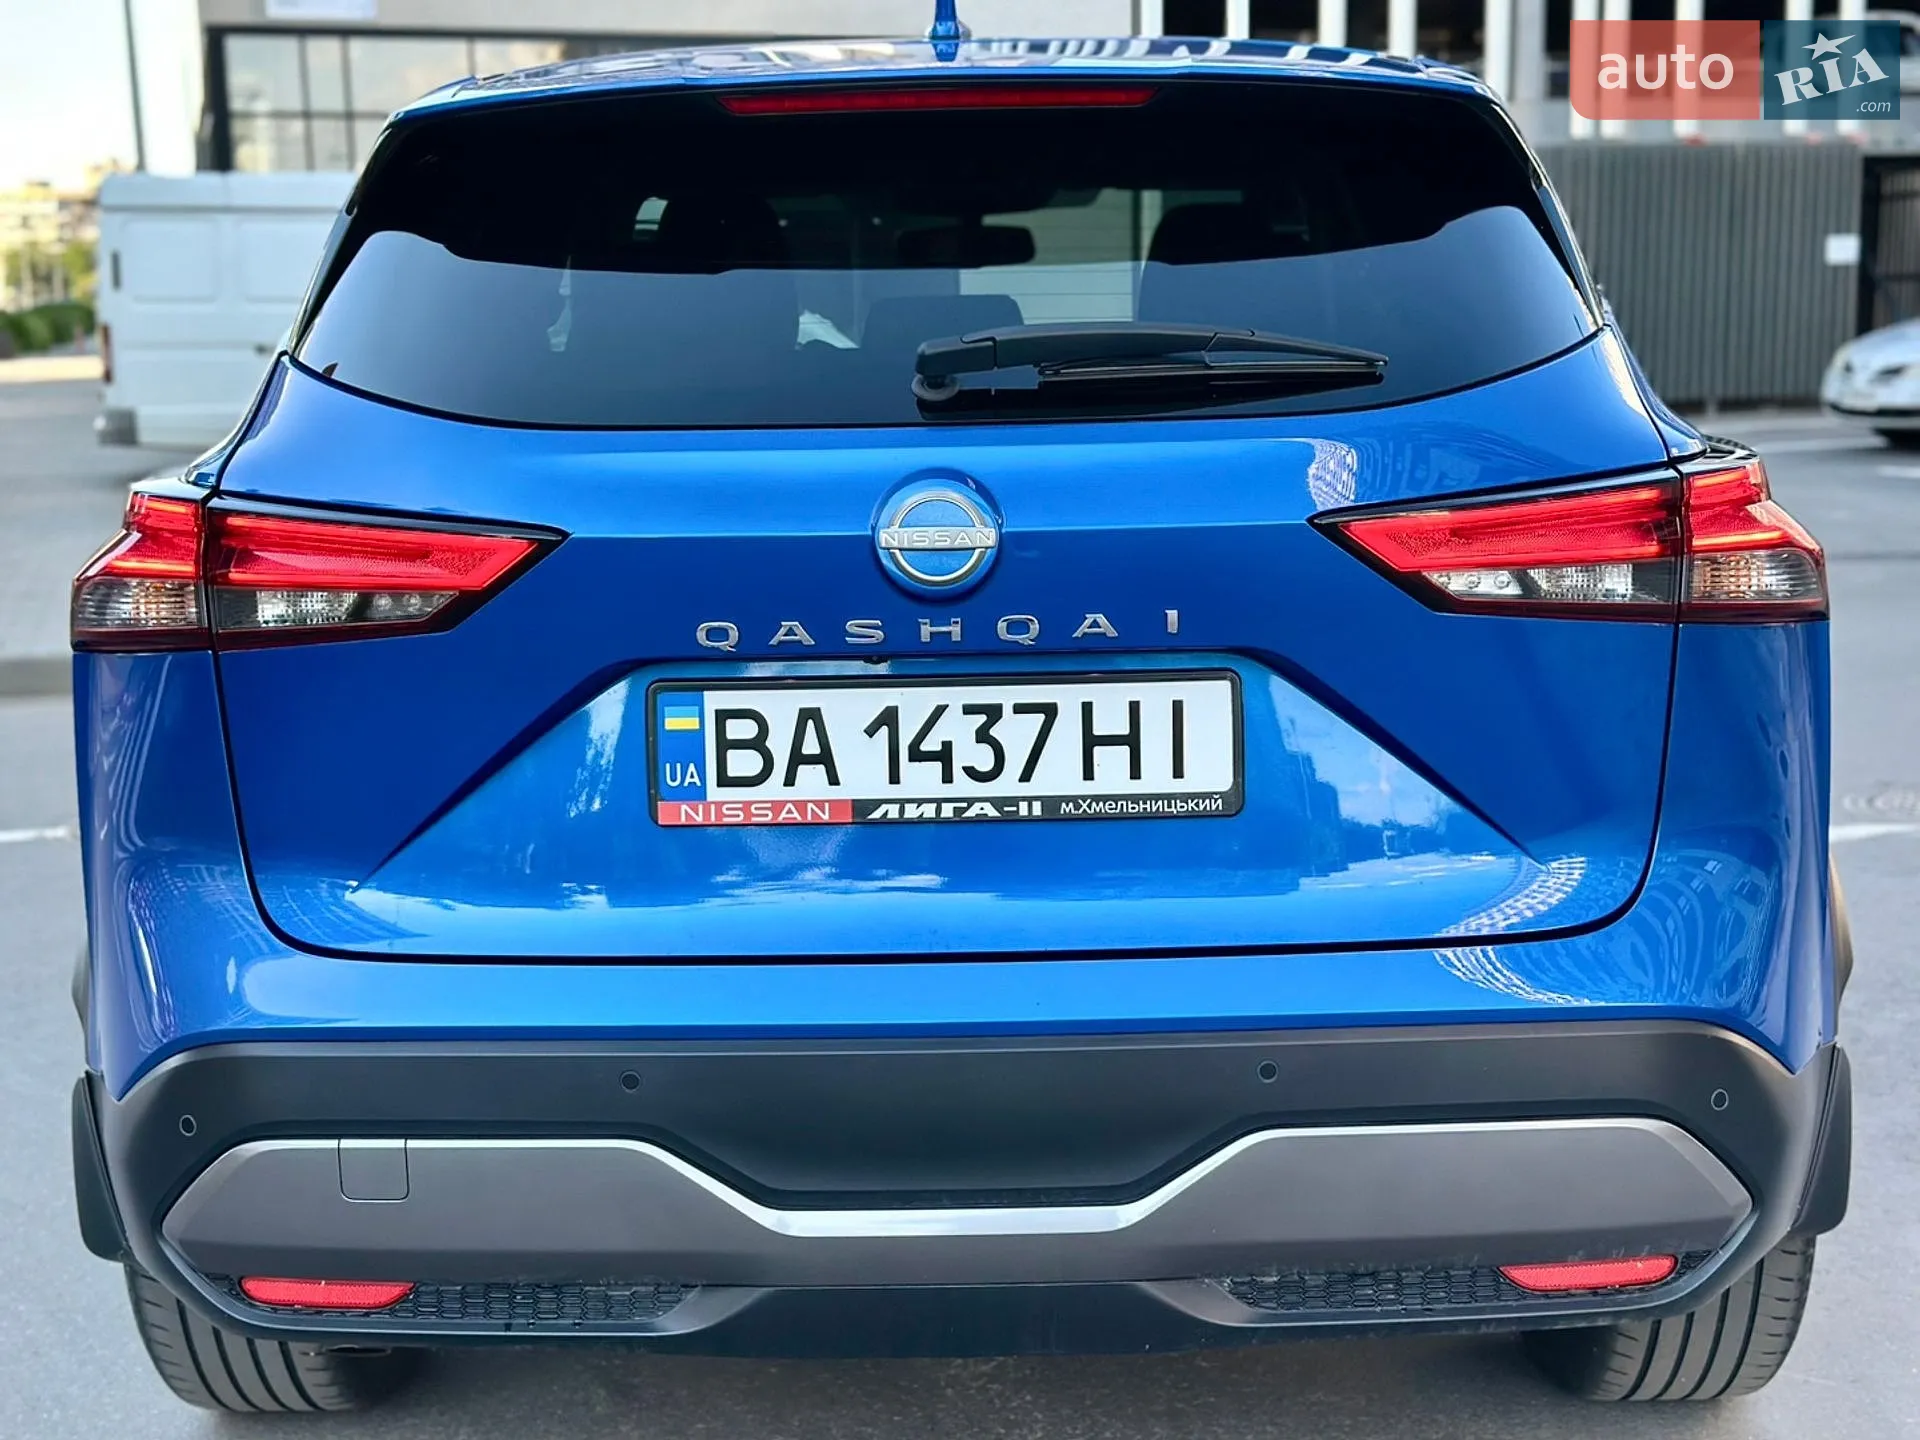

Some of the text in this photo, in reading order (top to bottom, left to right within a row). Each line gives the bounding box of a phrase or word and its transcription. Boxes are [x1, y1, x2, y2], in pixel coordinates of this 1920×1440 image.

[881, 530, 993, 547] NISSAN
[695, 608, 1181, 652] QASHQAI
[714, 706, 841, 789] BA
[863, 701, 1059, 786] 1437
[665, 762, 702, 787] UA
[680, 802, 830, 822] NISSAN
